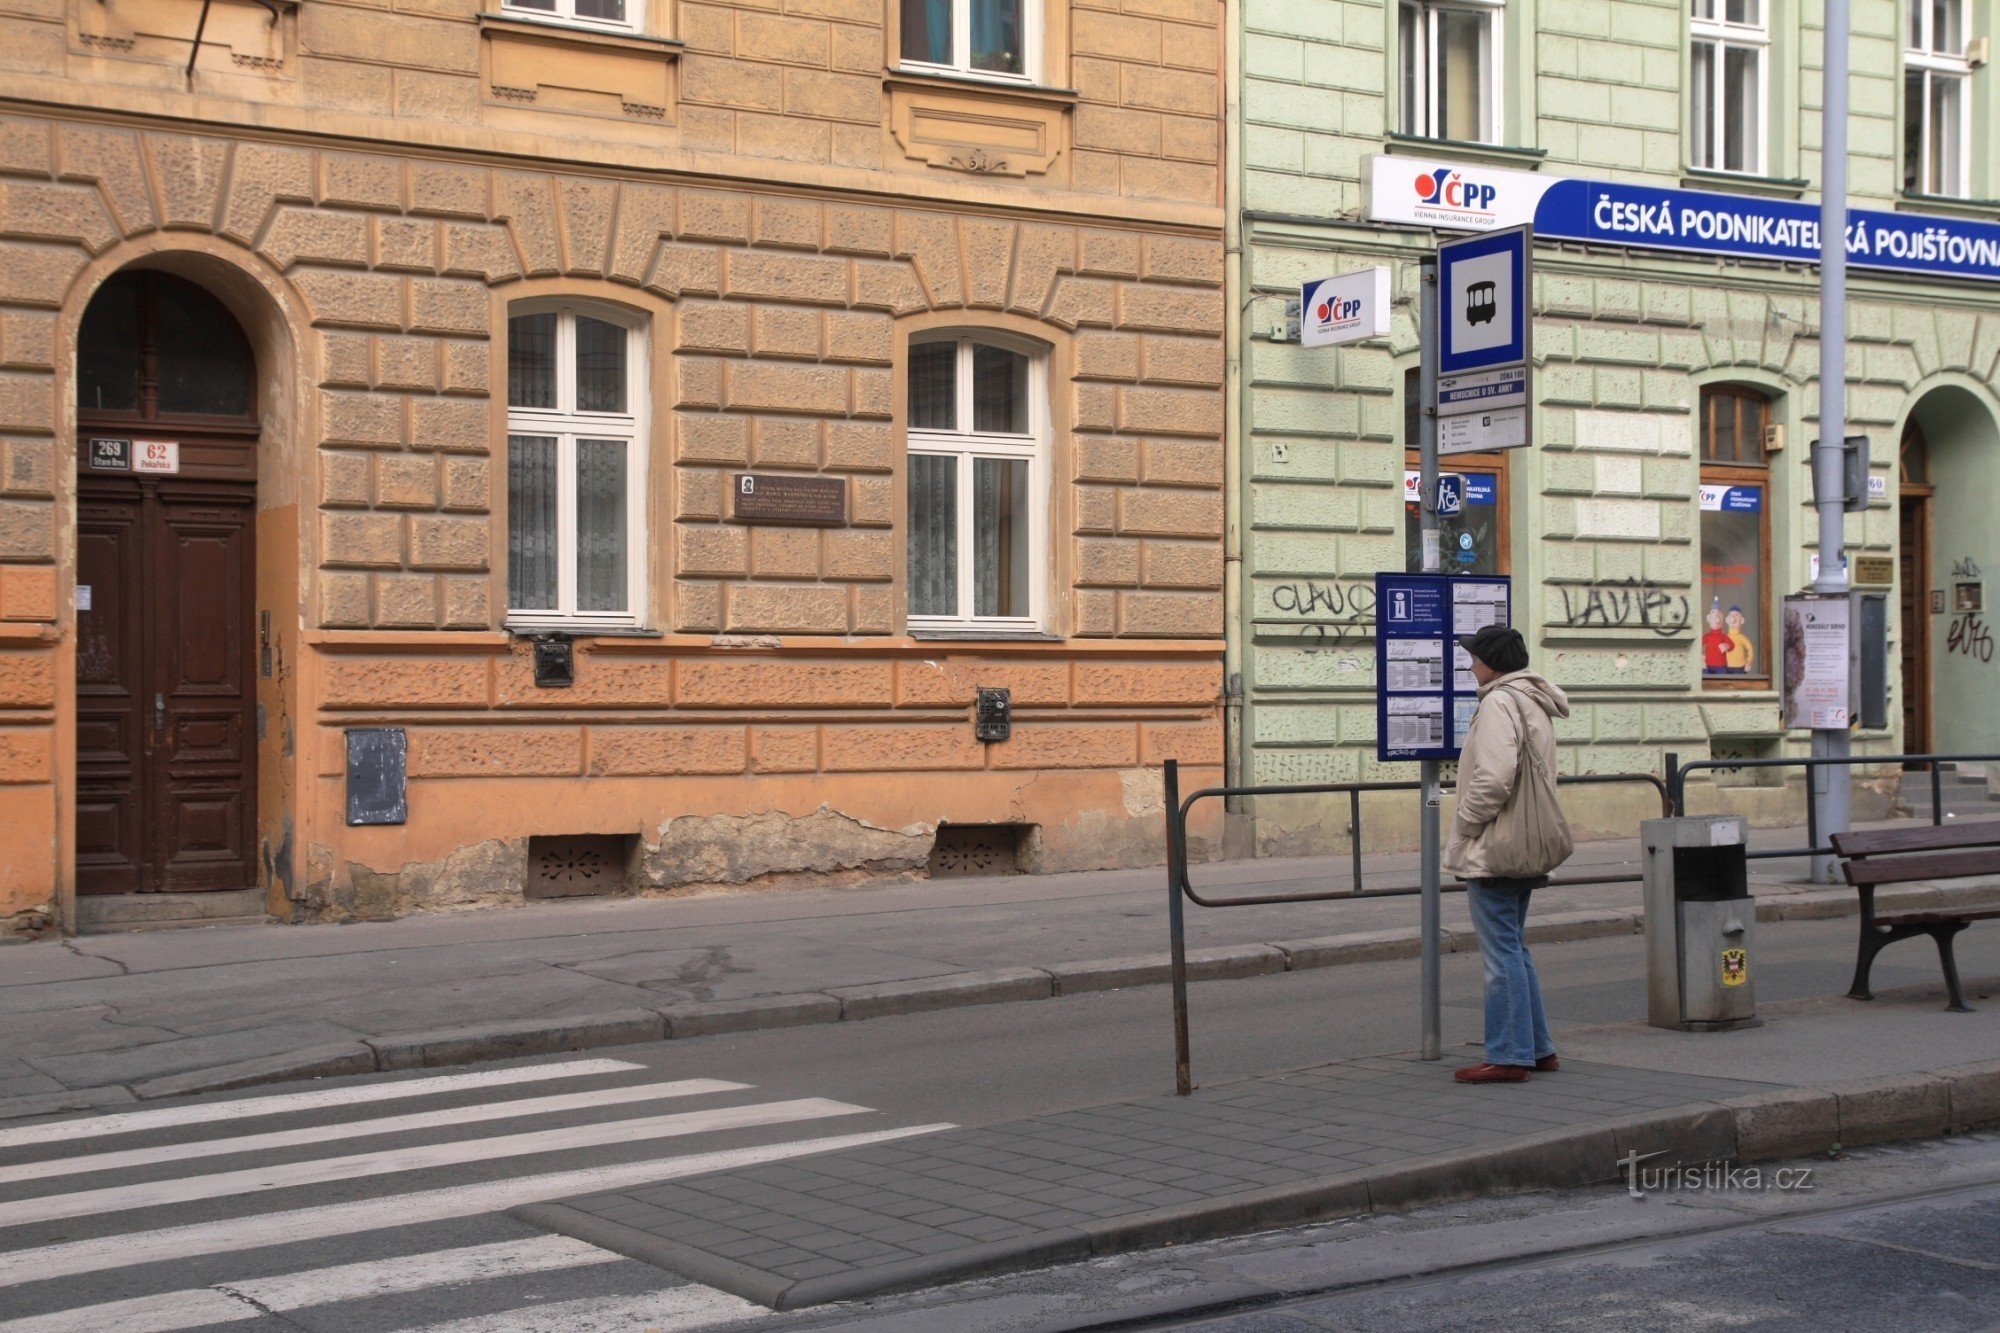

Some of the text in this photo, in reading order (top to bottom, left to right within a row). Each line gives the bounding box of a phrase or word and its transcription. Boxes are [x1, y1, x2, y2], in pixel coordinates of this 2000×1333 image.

[1446, 173, 1496, 210] ČPP
[1413, 210, 1496, 225] VIENNA INSURANCE GROUP
[1594, 194, 2000, 267] ČESKÁ PODNIKATELKÁ POJIŠŤOVN
[1333, 297, 1361, 320] ČPP
[1449, 383, 1513, 401] NEMOCNICE U SV. ANNY
[98, 441, 121, 456] 269
[146, 444, 167, 460] 62
